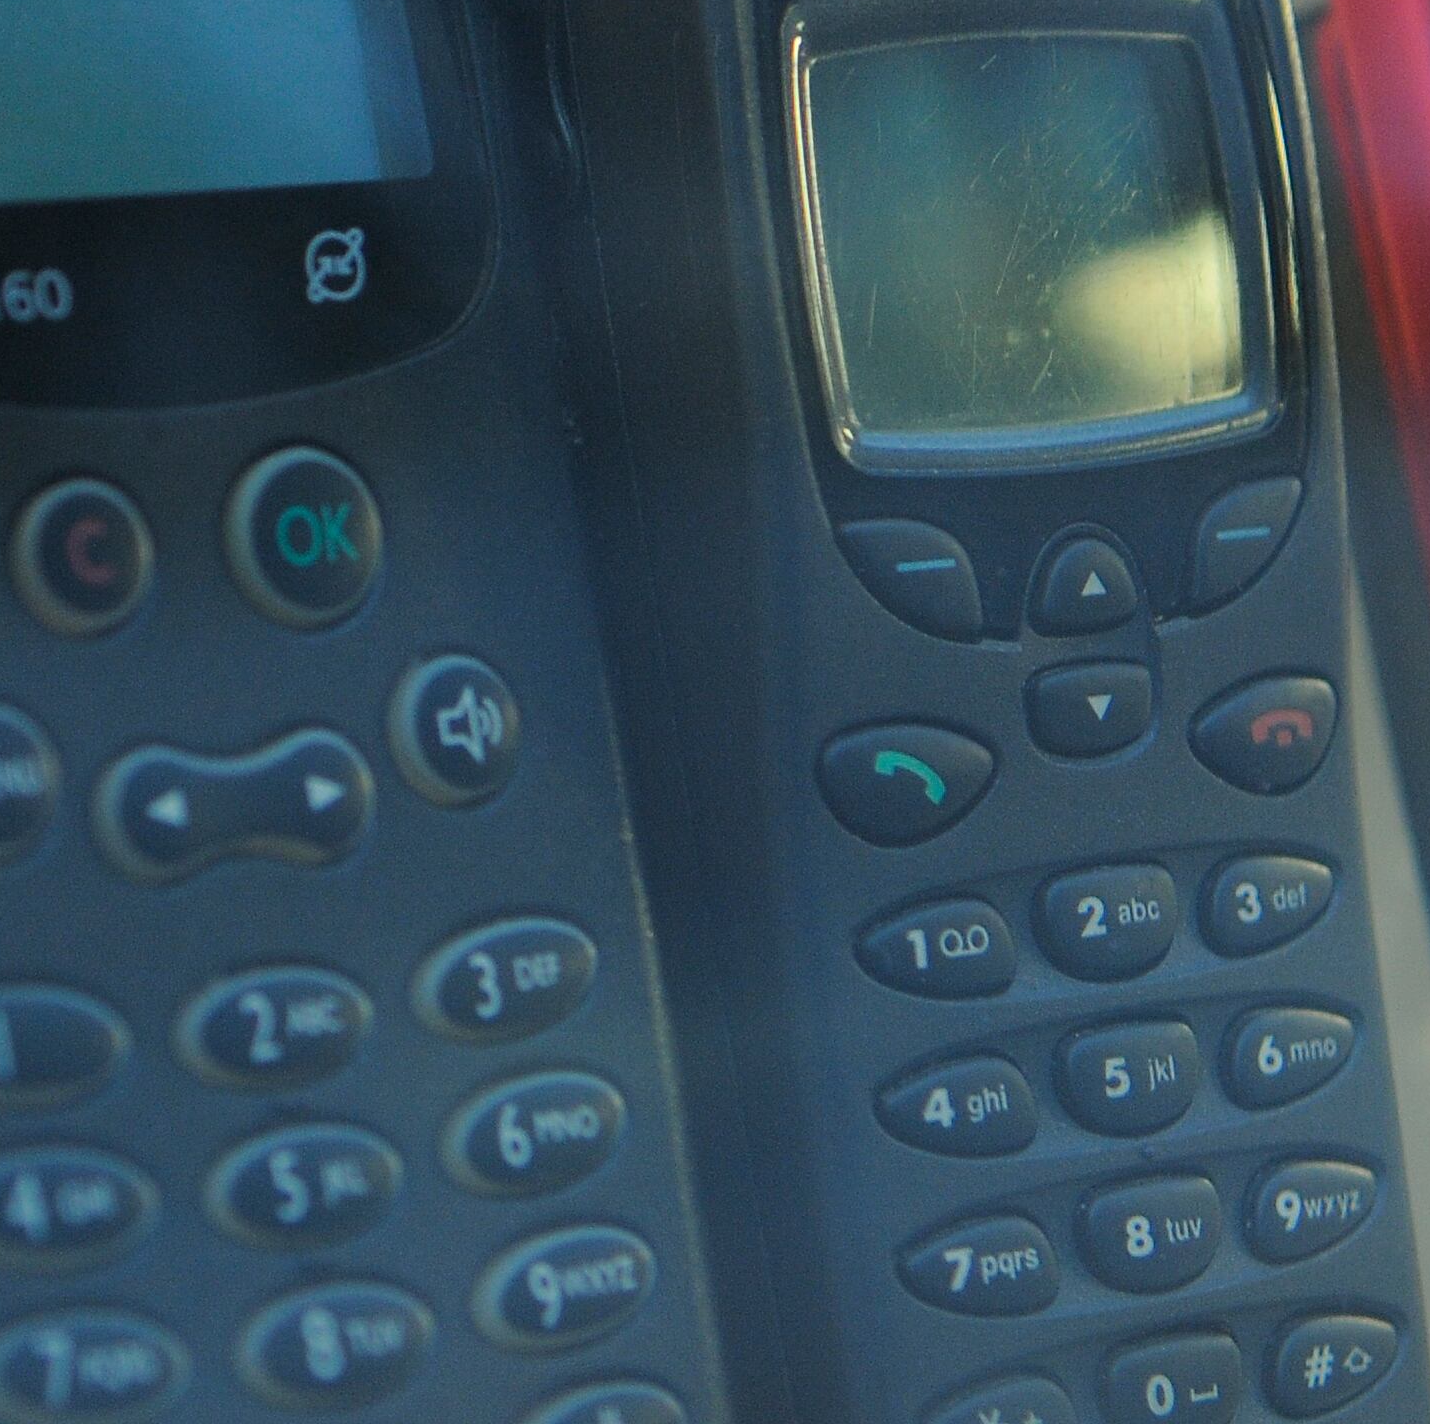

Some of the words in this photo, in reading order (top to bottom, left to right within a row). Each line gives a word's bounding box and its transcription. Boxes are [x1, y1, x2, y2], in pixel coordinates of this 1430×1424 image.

[65, 514, 112, 586] C
[275, 502, 361, 569] OK
[1077, 896, 1107, 938] 2
[1117, 896, 1161, 924] abc
[1234, 883, 1261, 924] 3
[1271, 882, 1307, 912] def
[906, 928, 929, 970] 1
[468, 951, 502, 1020] 3
[511, 950, 562, 989] DEF
[239, 991, 284, 1064] 2
[1104, 1057, 1131, 1098] 5
[1145, 1054, 1177, 1092] jkl
[1257, 1035, 1283, 1075] 6
[1289, 1034, 1337, 1064] mno
[922, 1087, 953, 1128] 4
[966, 1083, 1009, 1123] ghi
[497, 1103, 534, 1169] 6
[267, 1150, 311, 1225] 5
[1275, 1190, 1302, 1232] 9
[1125, 1215, 1155, 1259] 8
[1165, 1215, 1203, 1244] tuv
[943, 1247, 974, 1293] 7
[979, 1247, 1040, 1282] pqrs
[525, 1262, 564, 1331] 9
[1304, 1345, 1333, 1388] #
[1146, 1375, 1175, 1416] 0
